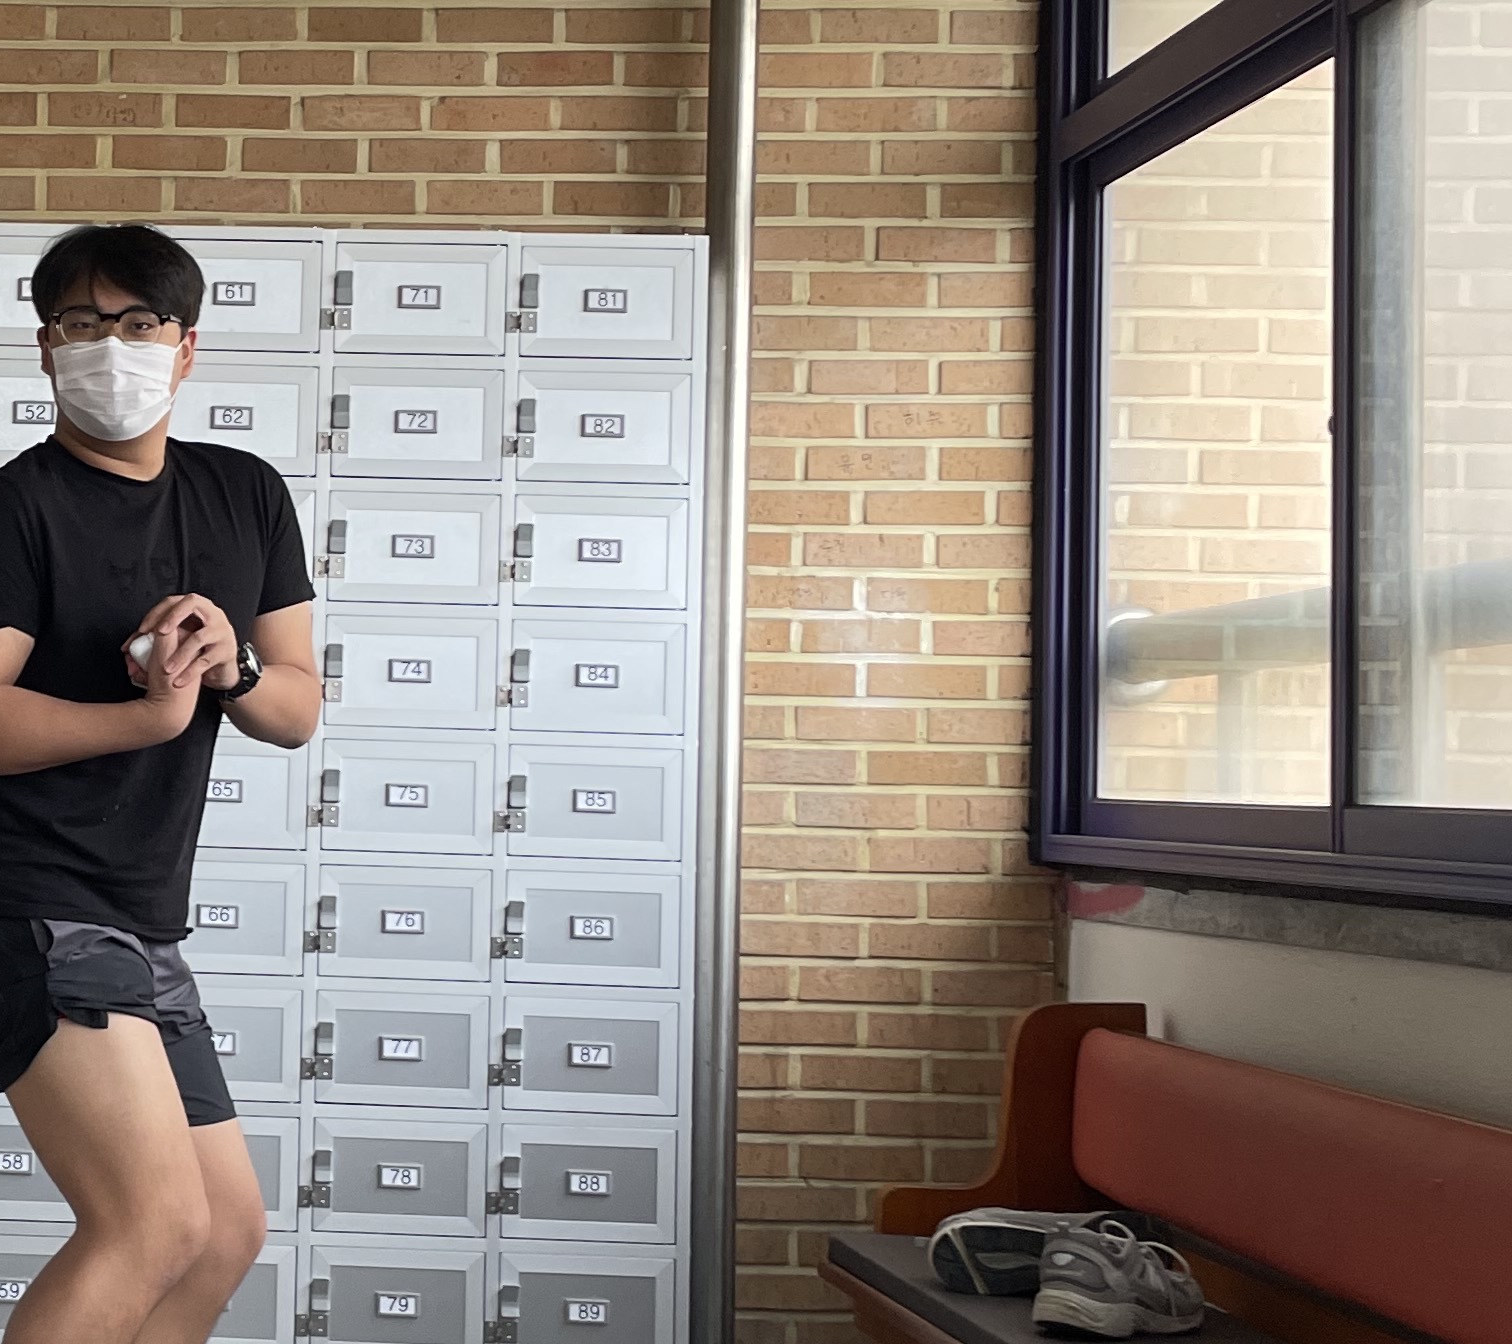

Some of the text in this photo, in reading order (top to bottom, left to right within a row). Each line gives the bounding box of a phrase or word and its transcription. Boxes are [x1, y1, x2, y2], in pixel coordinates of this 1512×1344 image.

[225, 285, 244, 299] 61
[410, 288, 429, 303] 71
[598, 292, 617, 307] 81
[25, 405, 46, 420] 52
[222, 409, 244, 424] 62
[407, 413, 428, 428] 72
[594, 419, 616, 434] 82
[404, 539, 425, 555] 73
[590, 542, 612, 556] 83
[401, 662, 422, 676] 74
[588, 667, 609, 681] 84
[213, 781, 232, 796] 65
[399, 786, 419, 801] 75
[585, 792, 606, 807] 85
[208, 907, 230, 922] 66
[395, 913, 415, 927] 76
[583, 920, 604, 935] 86
[392, 1039, 413, 1054] 77
[580, 1047, 602, 1062] 87
[1, 1155, 23, 1170] 58
[390, 1169, 412, 1184] 78
[578, 1176, 600, 1191] 88
[387, 1297, 409, 1312] 79
[578, 1304, 600, 1320] 89
